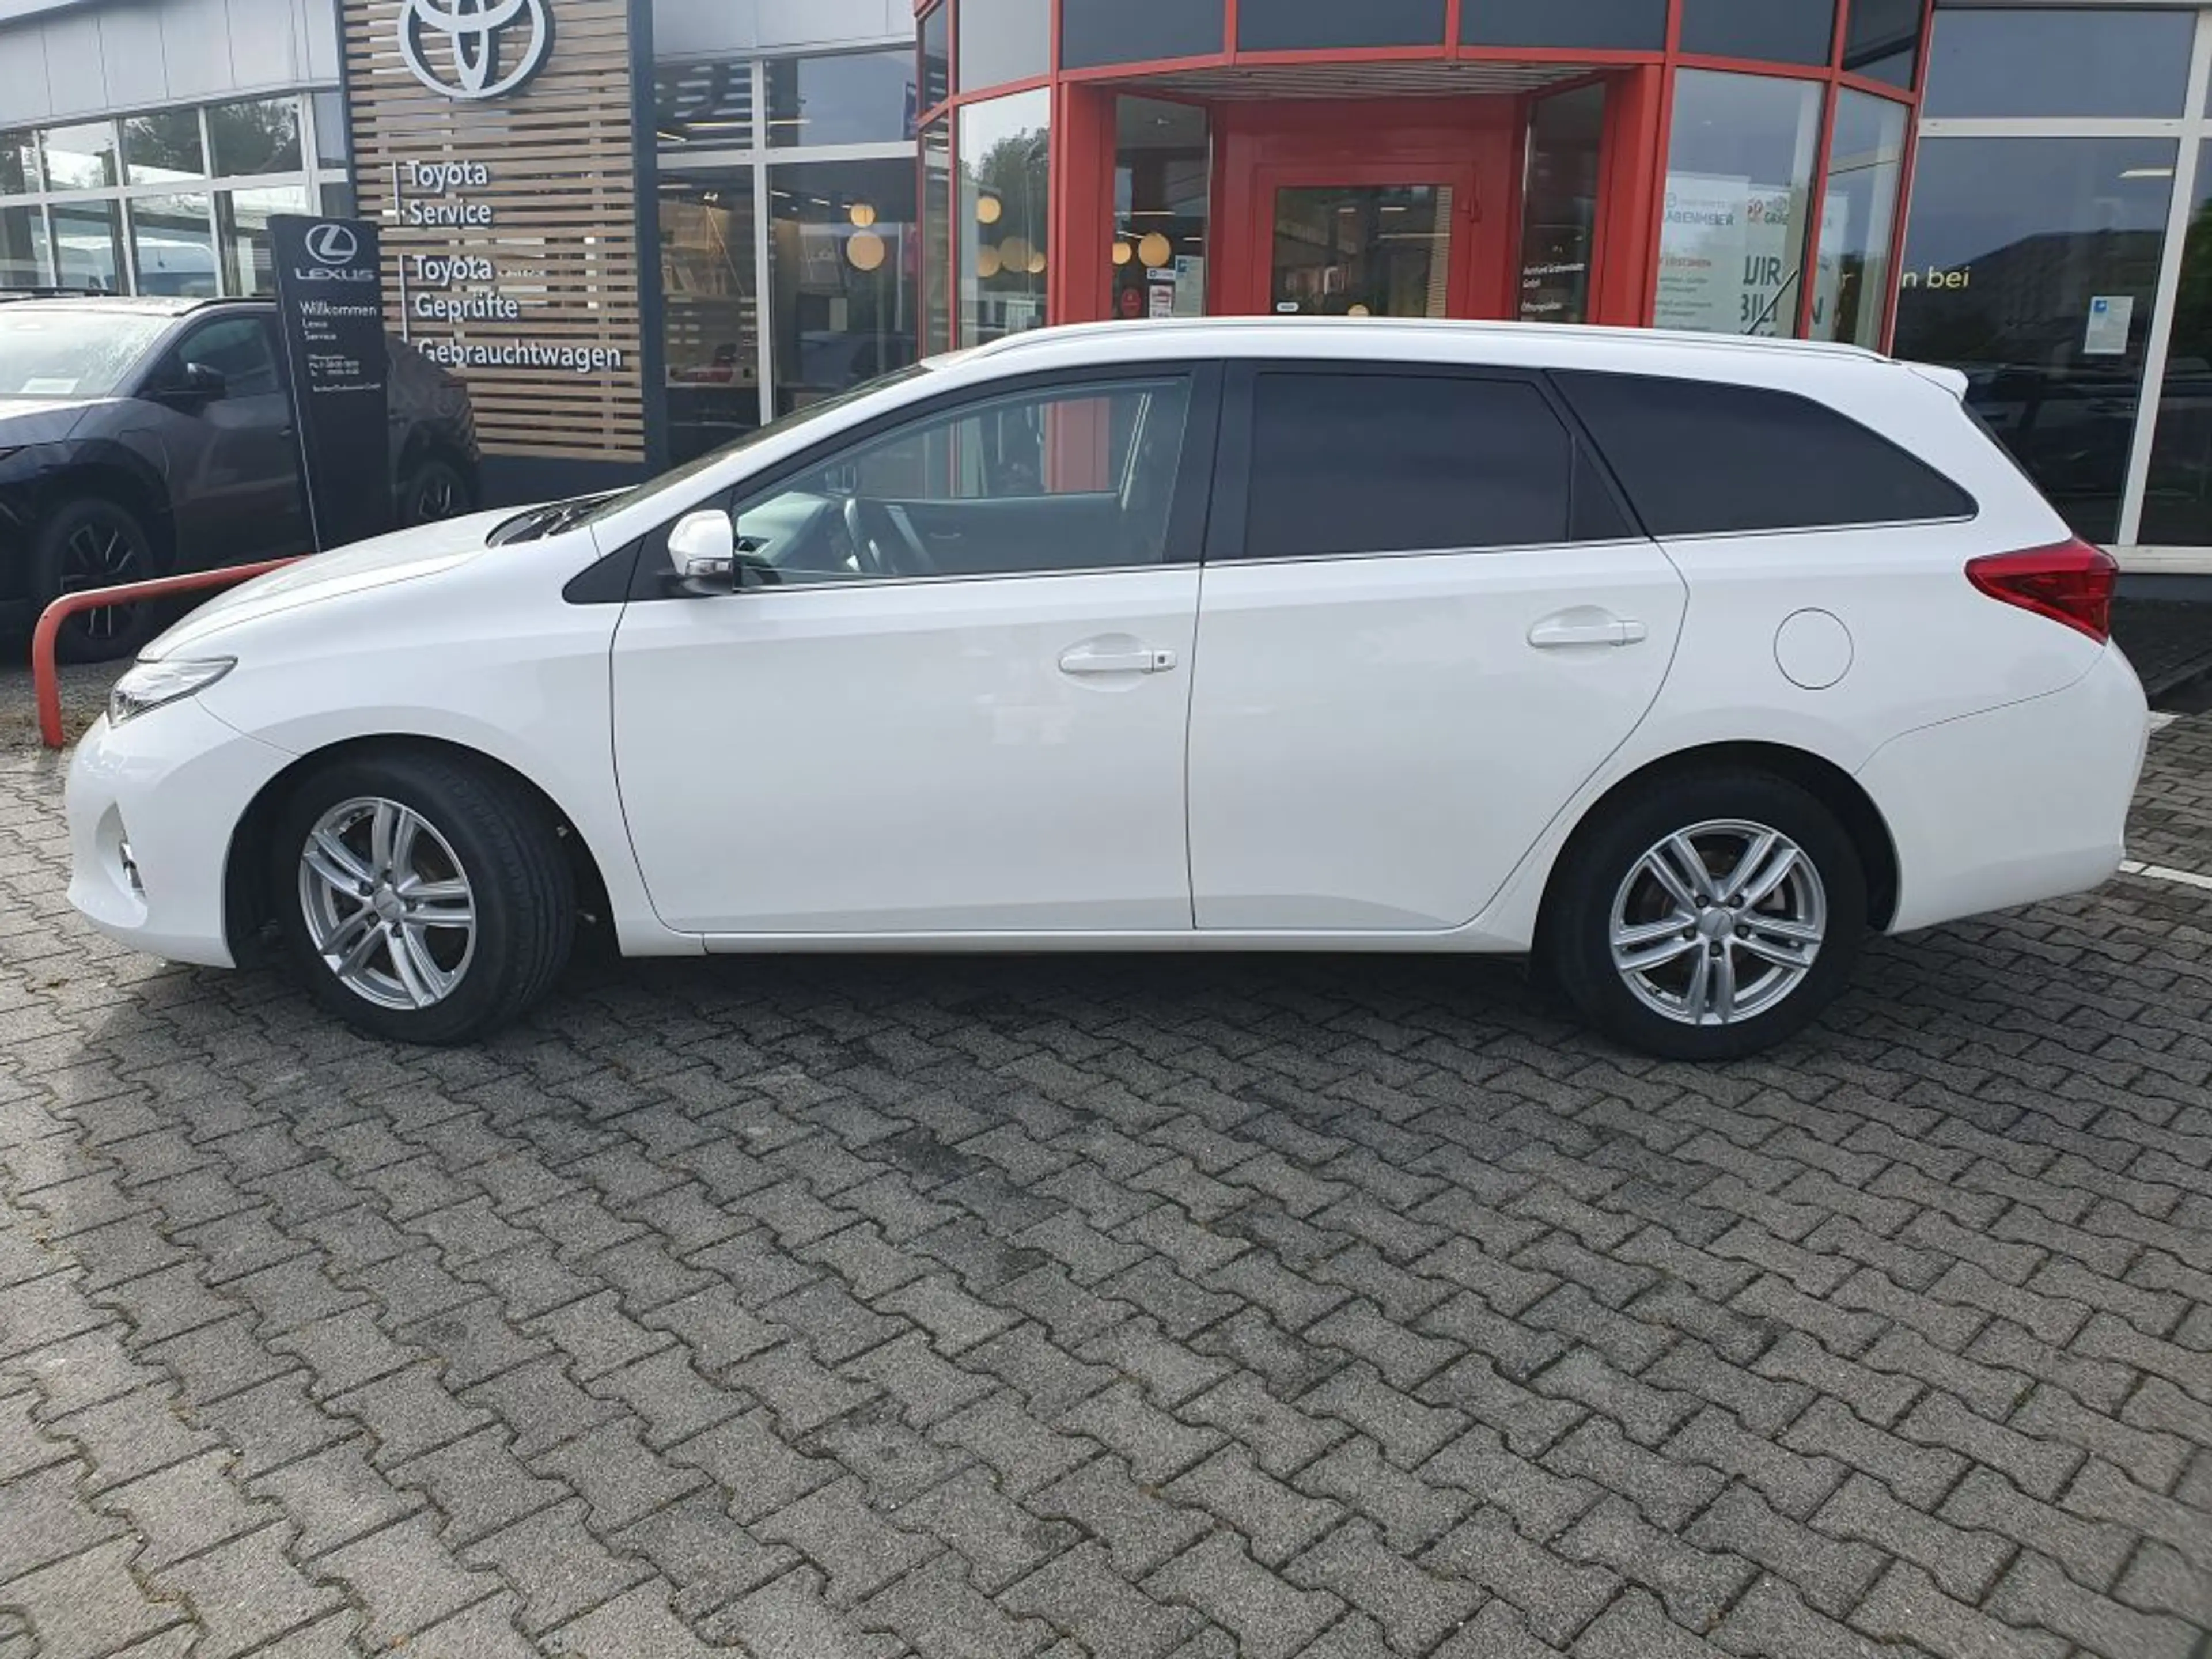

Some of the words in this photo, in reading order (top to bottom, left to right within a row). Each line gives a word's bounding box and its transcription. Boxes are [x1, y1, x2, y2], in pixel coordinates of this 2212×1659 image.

[407, 160, 488, 193] Toyota
[410, 199, 491, 225] Service
[294, 267, 375, 281] LEXUS
[412, 254, 494, 287] Toyota
[1927, 265, 1972, 289] bei
[299, 300, 377, 316] Willkommen
[415, 291, 518, 323] Geprüfte
[418, 338, 622, 373] Gebrauchtwagen
